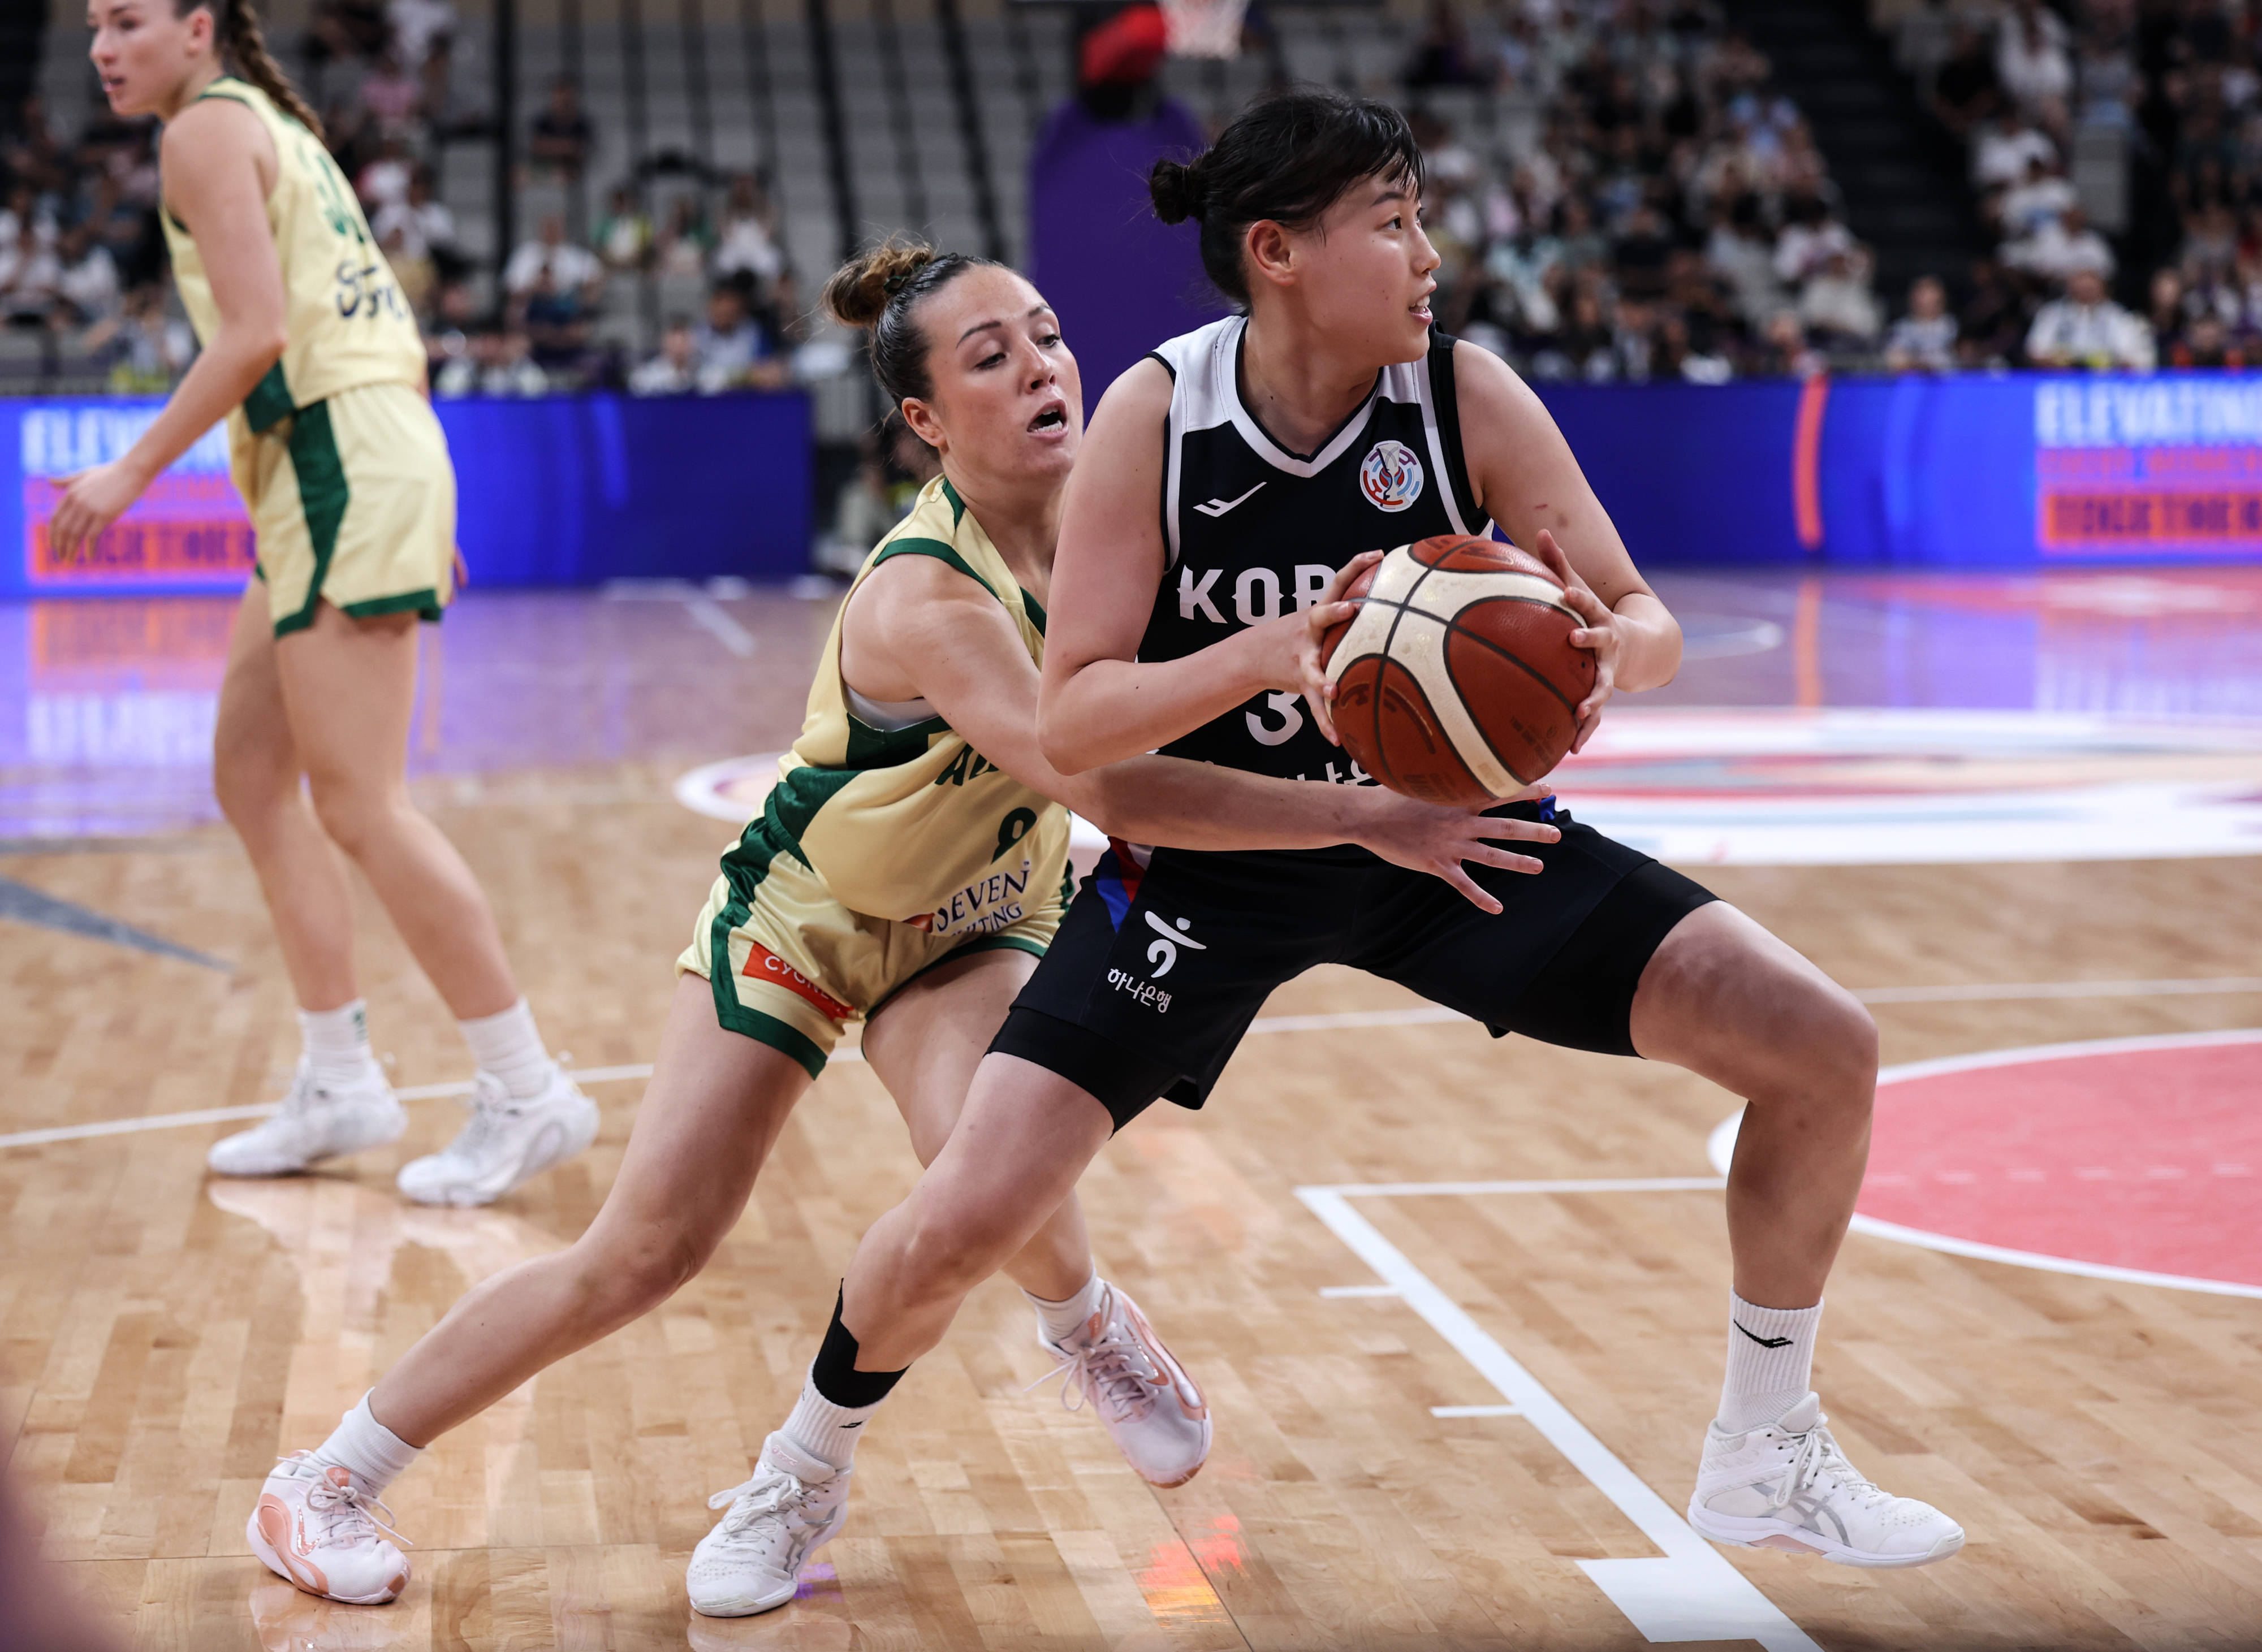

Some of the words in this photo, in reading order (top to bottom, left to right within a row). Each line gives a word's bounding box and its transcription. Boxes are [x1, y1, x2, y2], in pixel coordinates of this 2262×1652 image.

[1176, 564, 1337, 626] KOR
[936, 870, 1030, 932] SEVEN
[1107, 968, 1172, 1013] 하나은행
